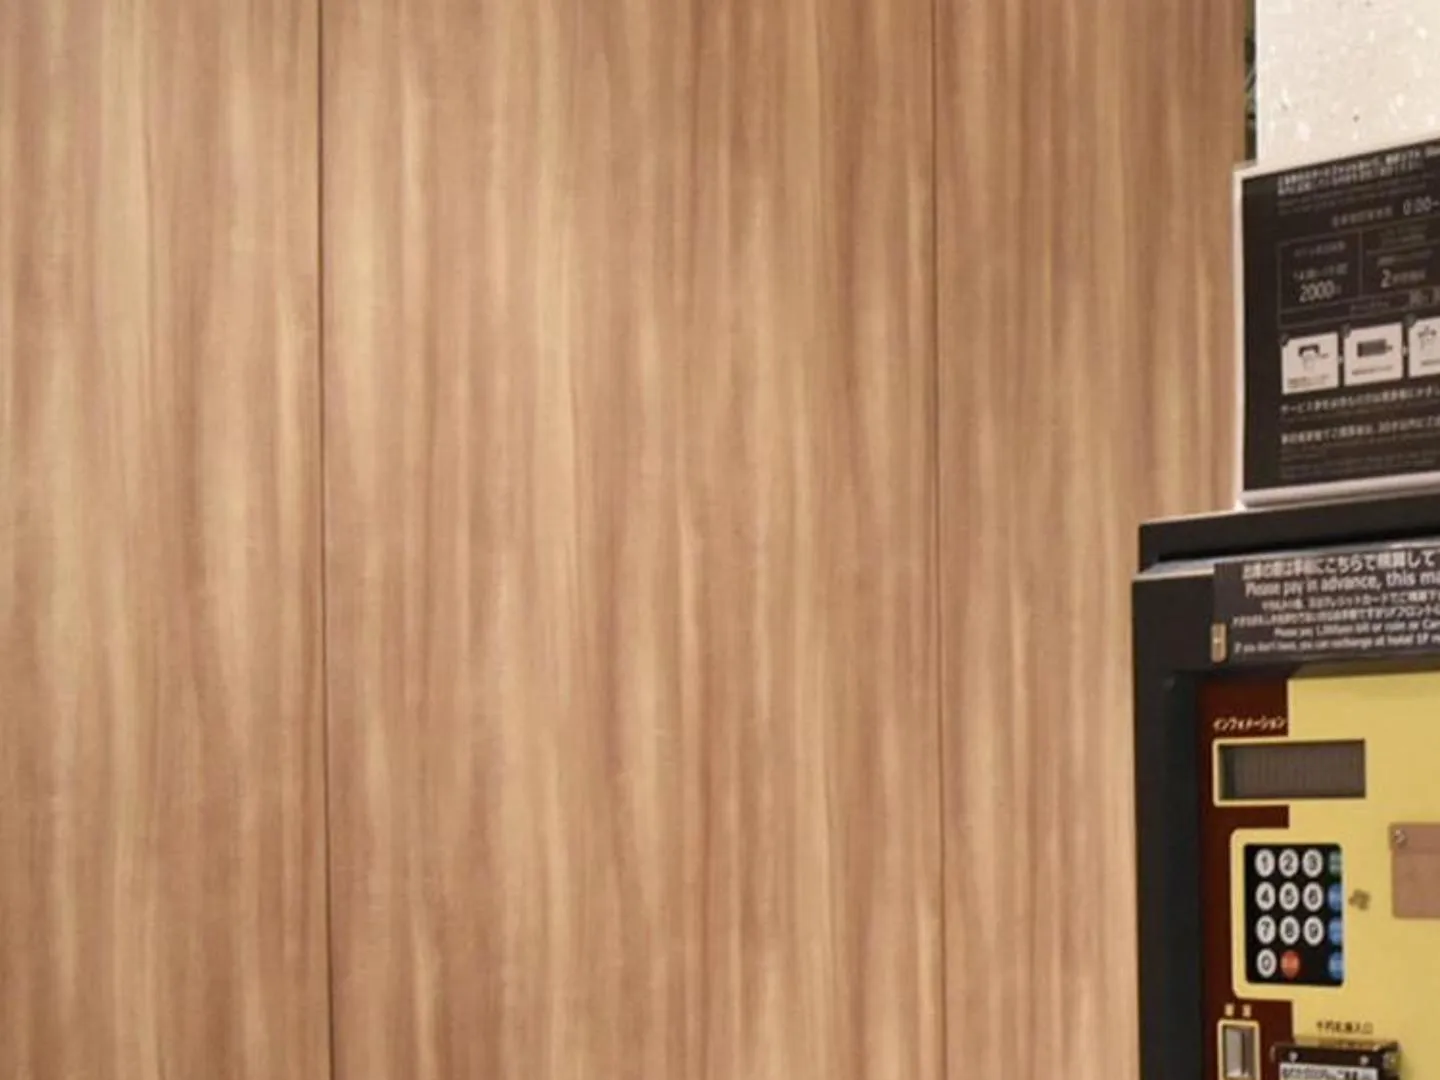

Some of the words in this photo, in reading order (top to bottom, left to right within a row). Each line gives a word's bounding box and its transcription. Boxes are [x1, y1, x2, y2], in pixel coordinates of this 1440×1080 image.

[1245, 581, 1281, 598] Please
[1284, 580, 1303, 599] pay
[1306, 576, 1319, 593] in
[1321, 575, 1382, 592] advance,
[1386, 570, 1416, 587] this
